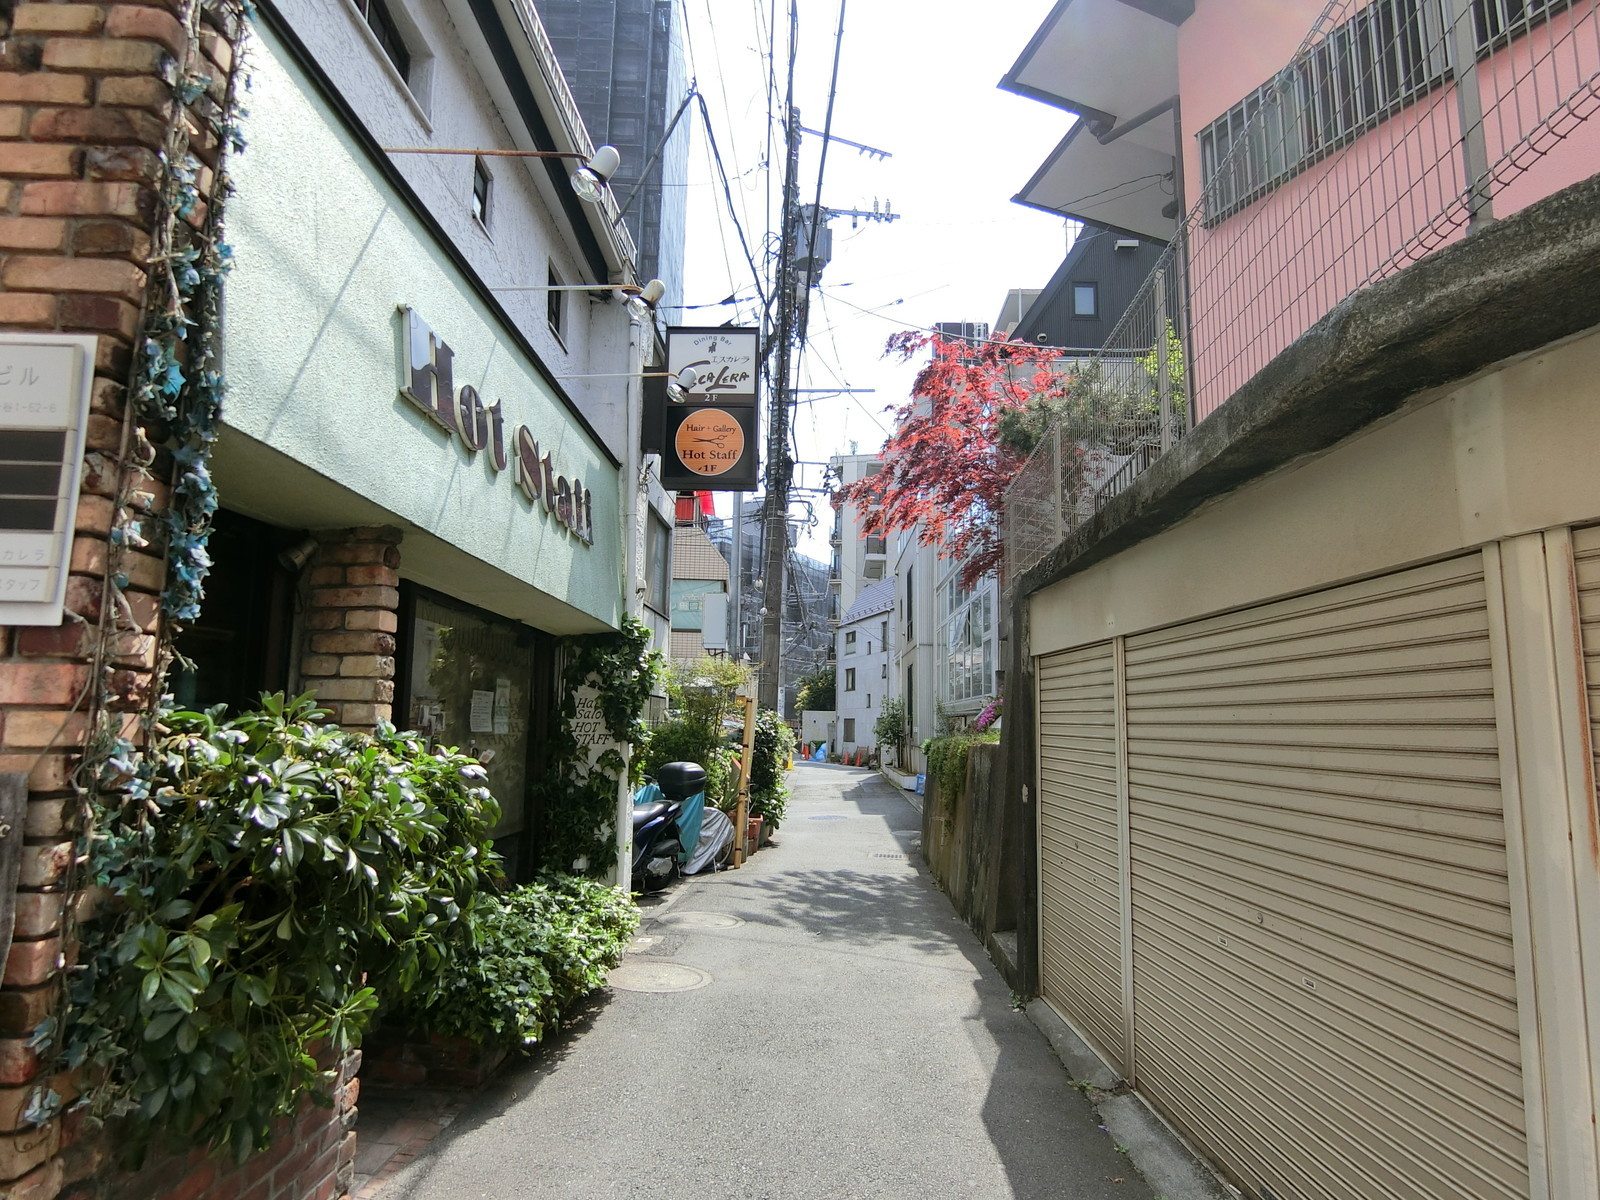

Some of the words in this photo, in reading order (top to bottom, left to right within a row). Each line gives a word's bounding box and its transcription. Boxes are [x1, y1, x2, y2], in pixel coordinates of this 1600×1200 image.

[693, 335, 718, 346] Dining
[720, 336, 732, 346] Bar
[704, 393, 718, 402] 2F
[686, 424, 705, 432] Hair
[713, 424, 737, 435] Gallery
[682, 449, 706, 460] Hot
[709, 449, 738, 460] Staff
[703, 464, 717, 472] 1F
[0, 579, 40, 592] タッフ
[574, 721, 601, 733] HOT
[575, 733, 612, 745] STAFF
